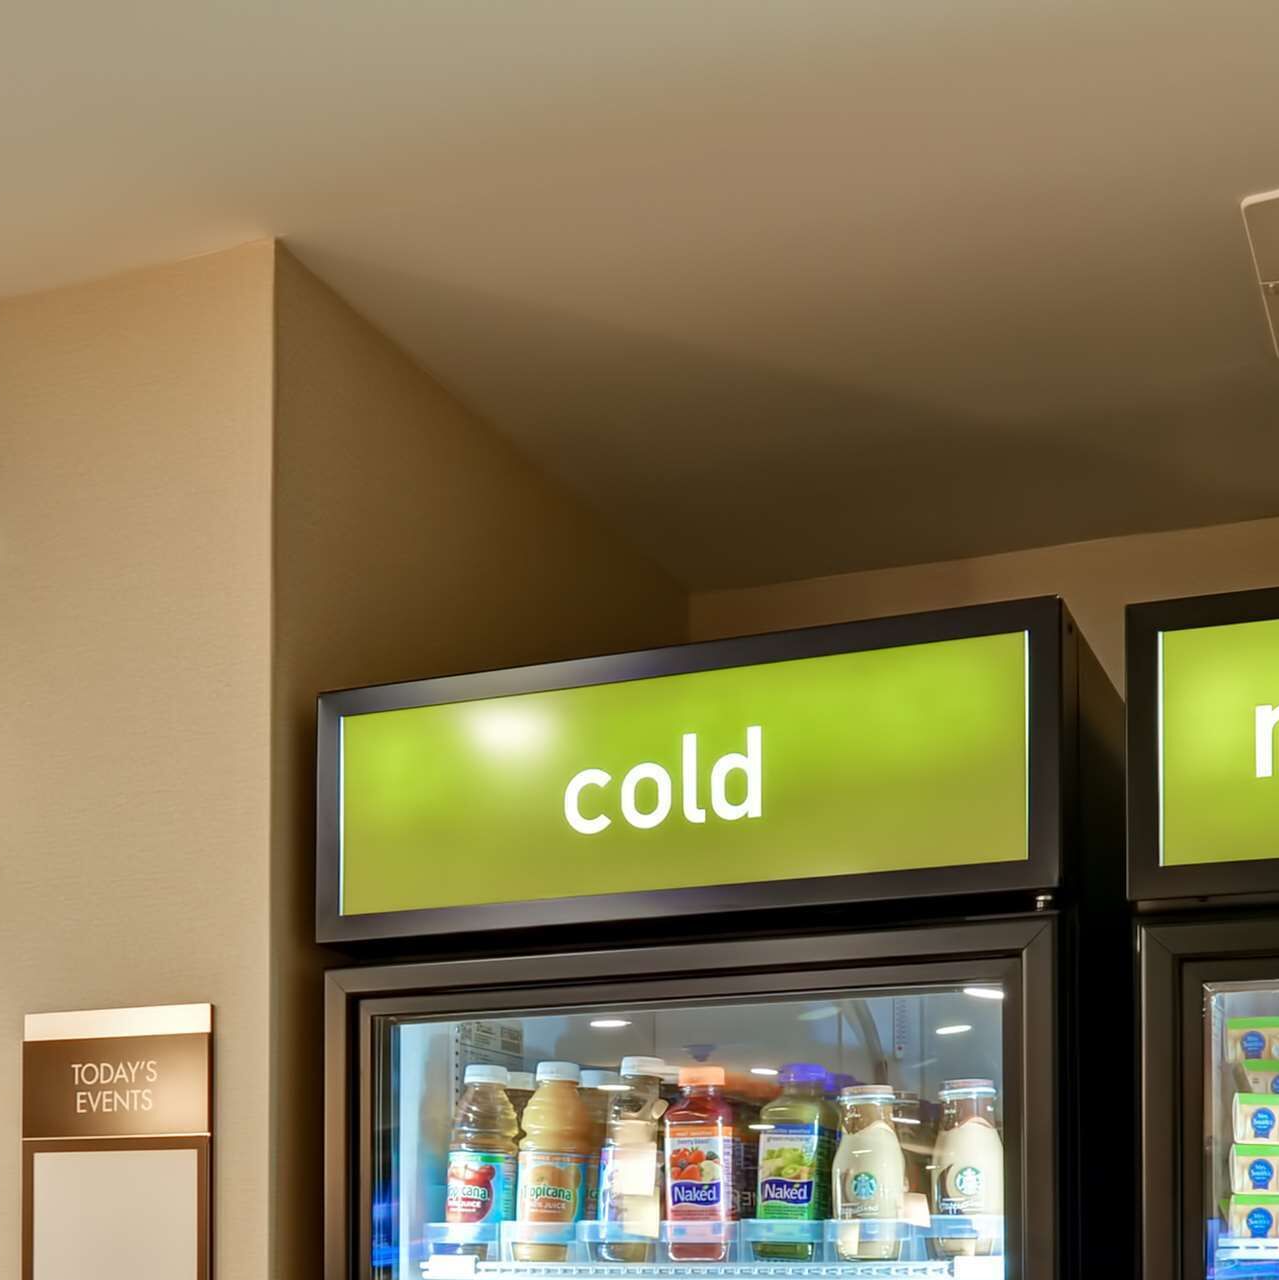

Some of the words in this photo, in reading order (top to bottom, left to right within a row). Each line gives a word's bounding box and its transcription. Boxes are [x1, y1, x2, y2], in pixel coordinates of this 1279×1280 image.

[563, 725, 762, 834] cold
[71, 1060, 158, 1085] TODAY'S
[76, 1089, 153, 1113] EVENTS
[673, 1184, 718, 1202] Naked
[764, 1182, 809, 1200] Naked
